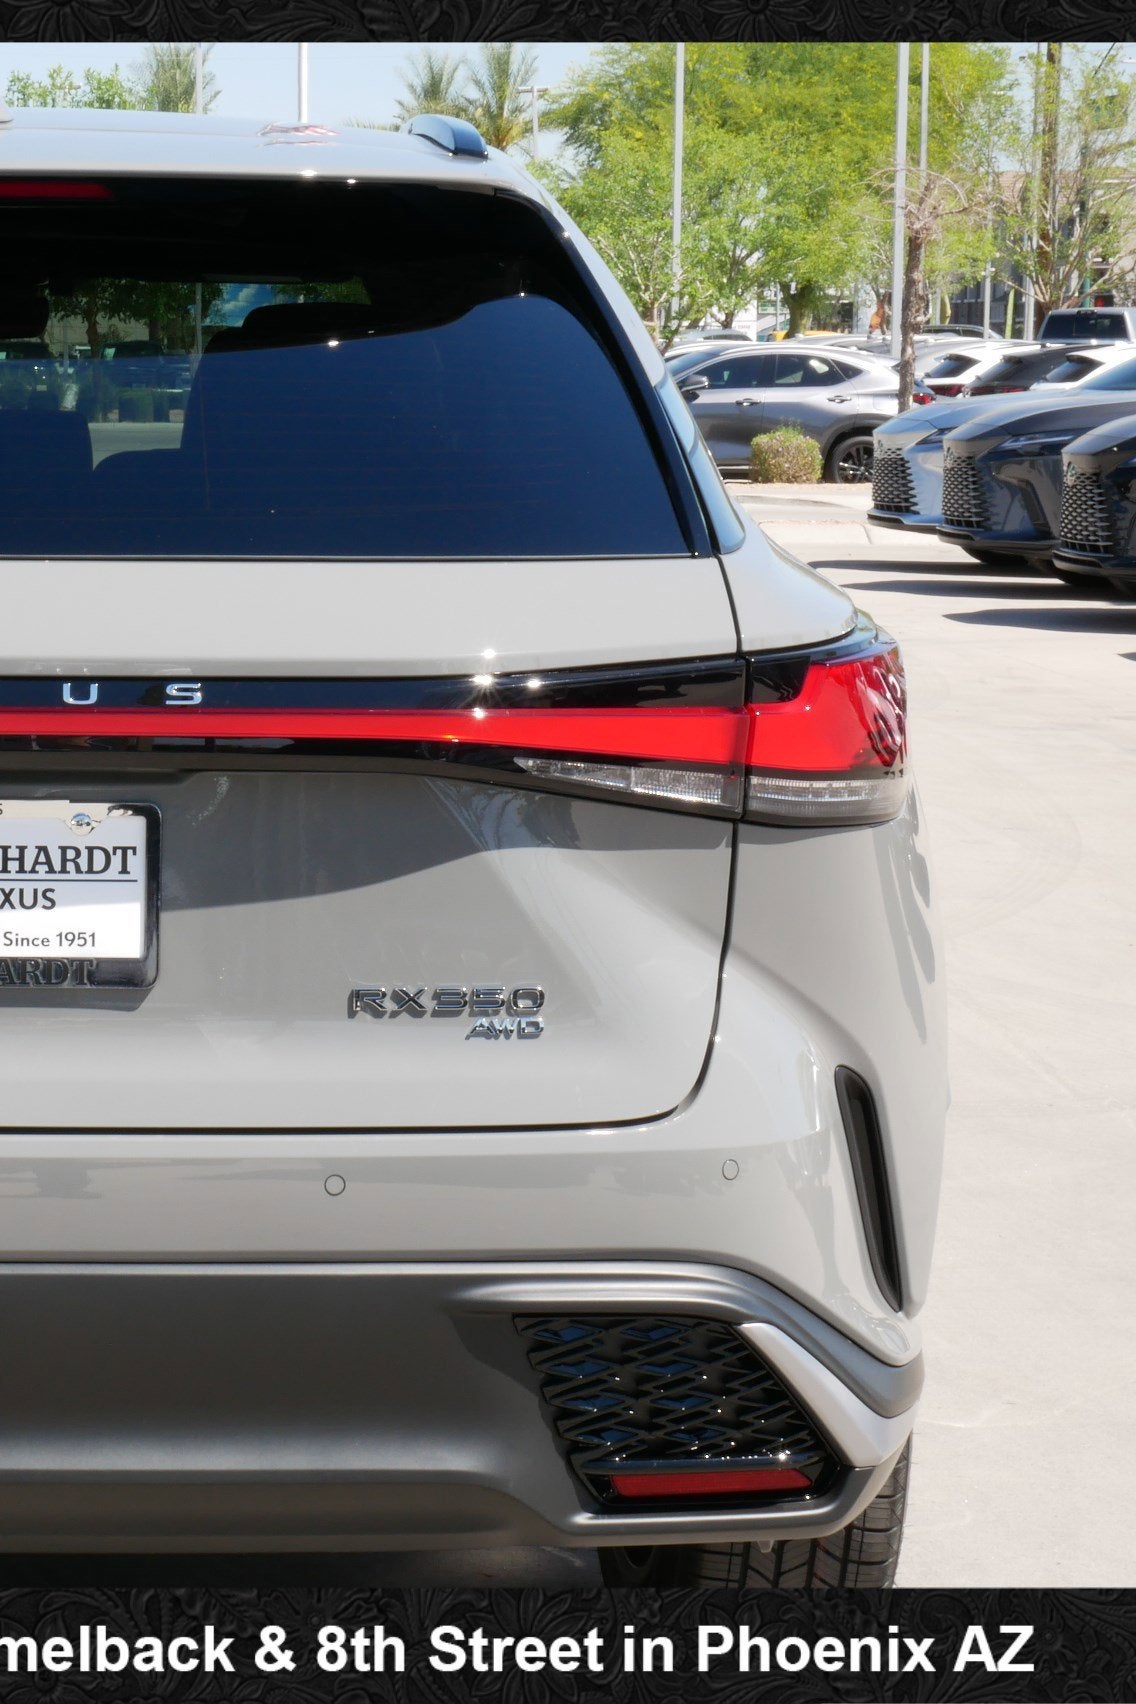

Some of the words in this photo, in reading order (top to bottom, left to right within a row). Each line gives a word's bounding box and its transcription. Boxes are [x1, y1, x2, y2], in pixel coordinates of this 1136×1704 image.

[3, 931, 50, 947] Since
[56, 932, 96, 947] 1951
[468, 1017, 545, 1037] AWD
